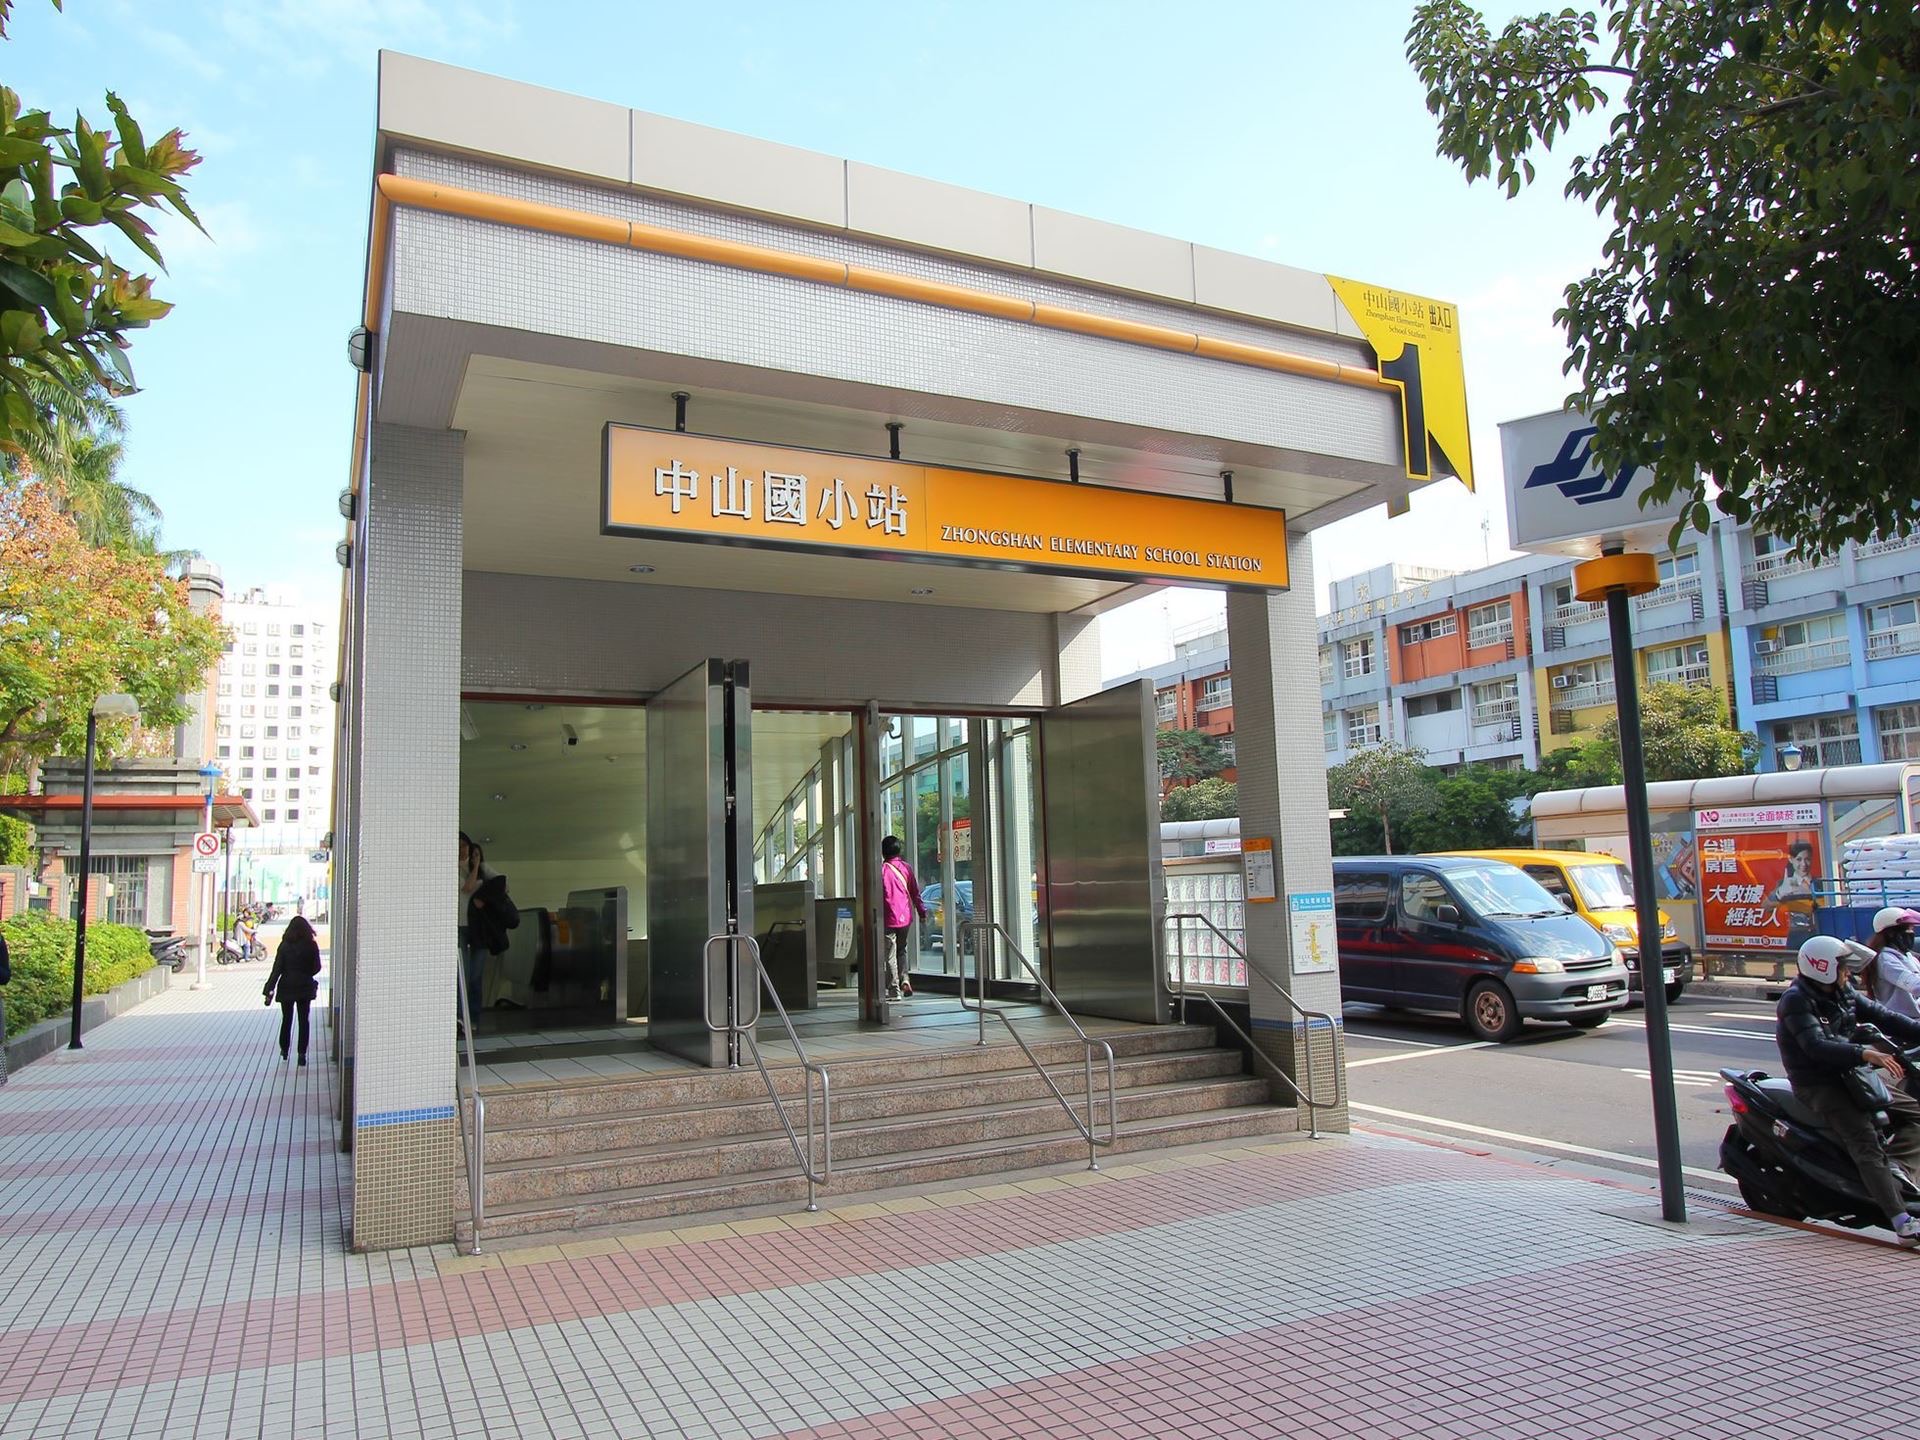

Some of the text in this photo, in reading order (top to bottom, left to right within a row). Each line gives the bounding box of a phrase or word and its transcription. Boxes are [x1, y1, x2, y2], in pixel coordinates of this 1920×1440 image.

[1363, 290, 1452, 328] 中山國小站 出入口
[1396, 315, 1425, 328] Elementary
[1388, 325, 1406, 335] School
[1406, 328, 1427, 339] Station
[1381, 343, 1428, 475] 1
[655, 459, 908, 537] 中山國小站
[941, 525, 1262, 571] ZHONGSHAN ELEMENTARY SCHOOL STATION
[1703, 838, 1736, 855] 台灣
[1705, 857, 1738, 873] 房屋
[1707, 884, 1765, 904] 大數據
[1724, 907, 1781, 928] 經紀人
